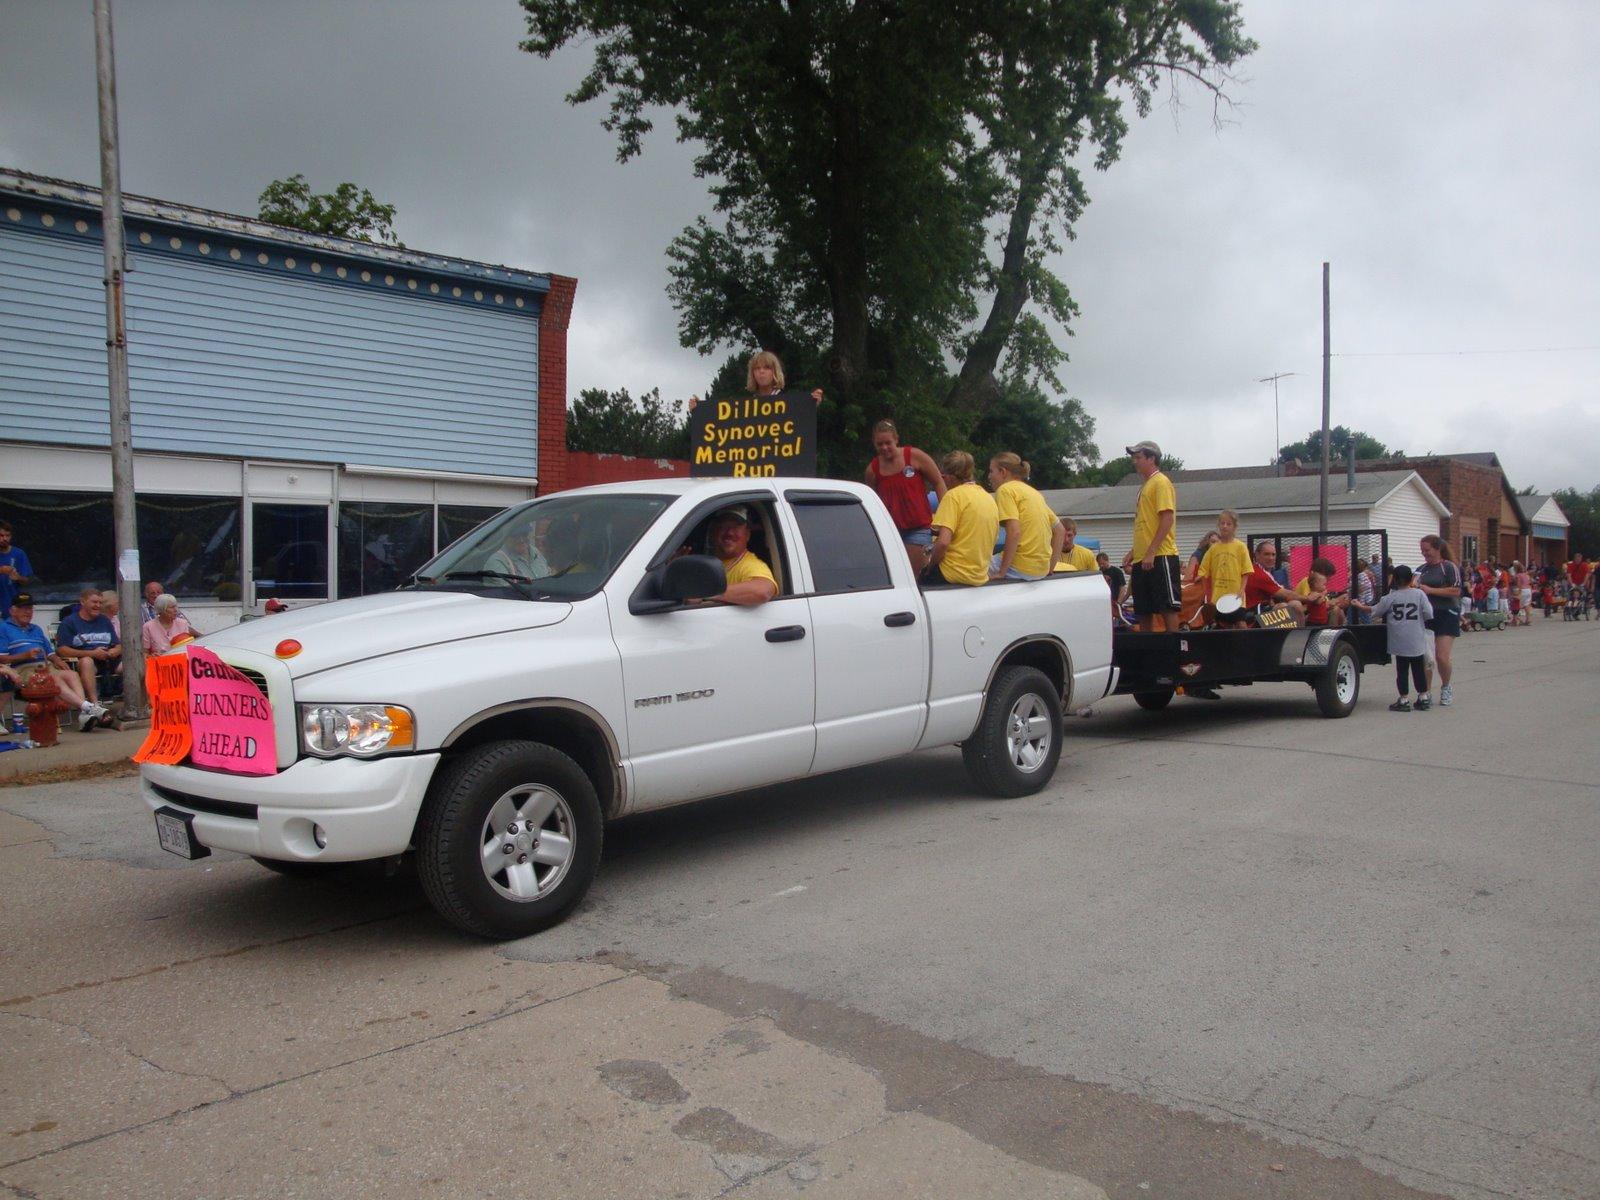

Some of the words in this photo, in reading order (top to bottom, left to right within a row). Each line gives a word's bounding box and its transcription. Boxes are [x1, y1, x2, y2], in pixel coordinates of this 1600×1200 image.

[717, 398, 787, 420] Dillon
[703, 420, 794, 447] Synovec
[695, 436, 802, 465] Memorial
[733, 462, 776, 478] Run
[1260, 607, 1291, 626] DILLON
[1392, 603, 1418, 621] 52
[675, 688, 715, 702] 1500
[191, 693, 269, 721] RUNNERS
[198, 731, 258, 759] AHEAD
